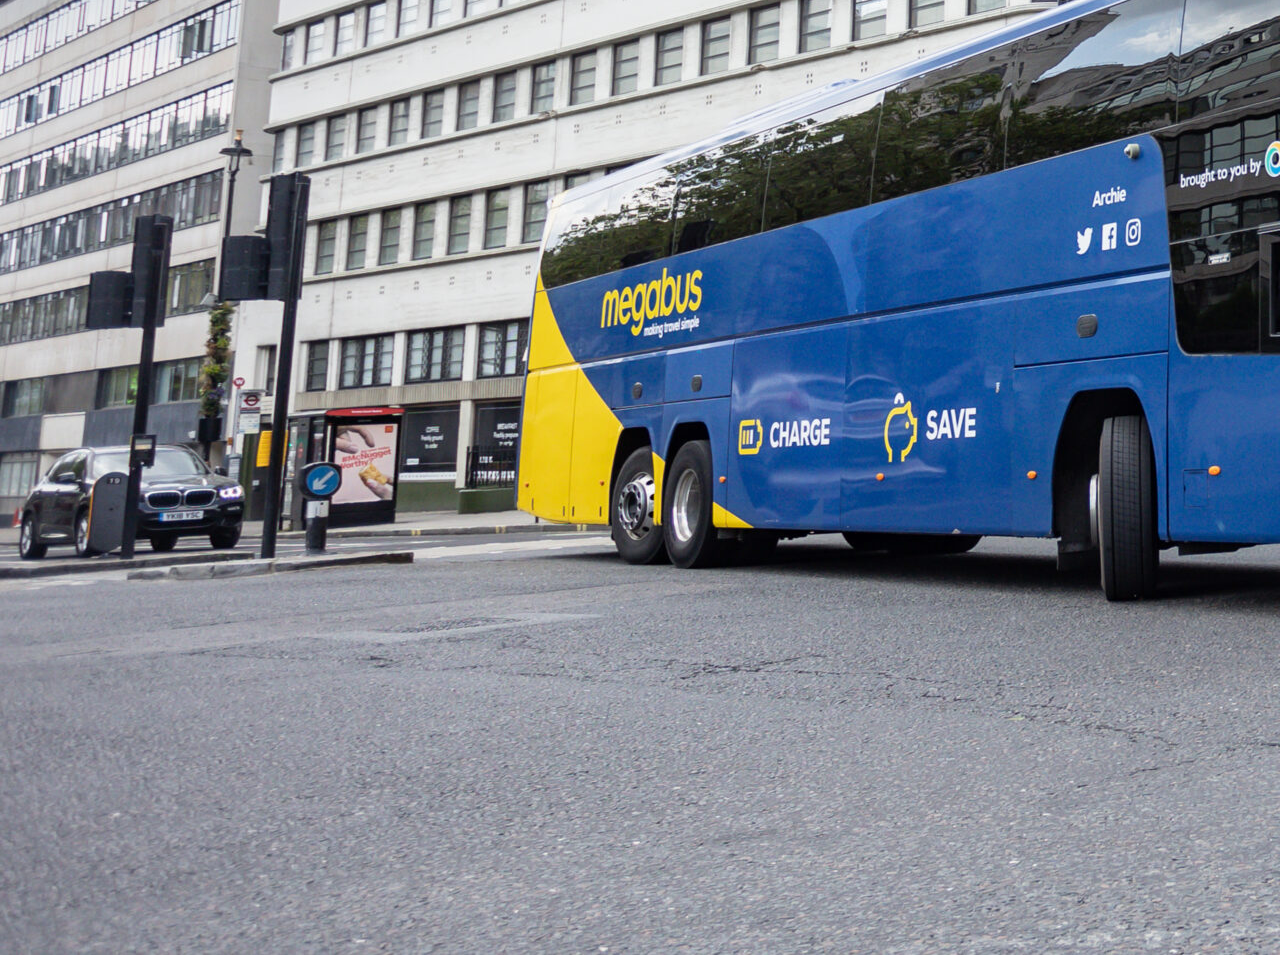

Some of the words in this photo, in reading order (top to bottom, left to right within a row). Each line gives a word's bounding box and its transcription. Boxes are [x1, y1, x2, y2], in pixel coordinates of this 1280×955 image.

[1180, 168, 1215, 188] brought
[1217, 166, 1228, 181] to
[1230, 165, 1247, 182] you
[1250, 158, 1261, 177] by
[1092, 186, 1127, 207] Archie
[601, 267, 703, 336] megabus
[643, 322, 664, 338] making
[664, 318, 681, 333] travel
[681, 315, 700, 332] simple
[770, 418, 831, 448] CHARGE
[926, 408, 976, 441] SAVE
